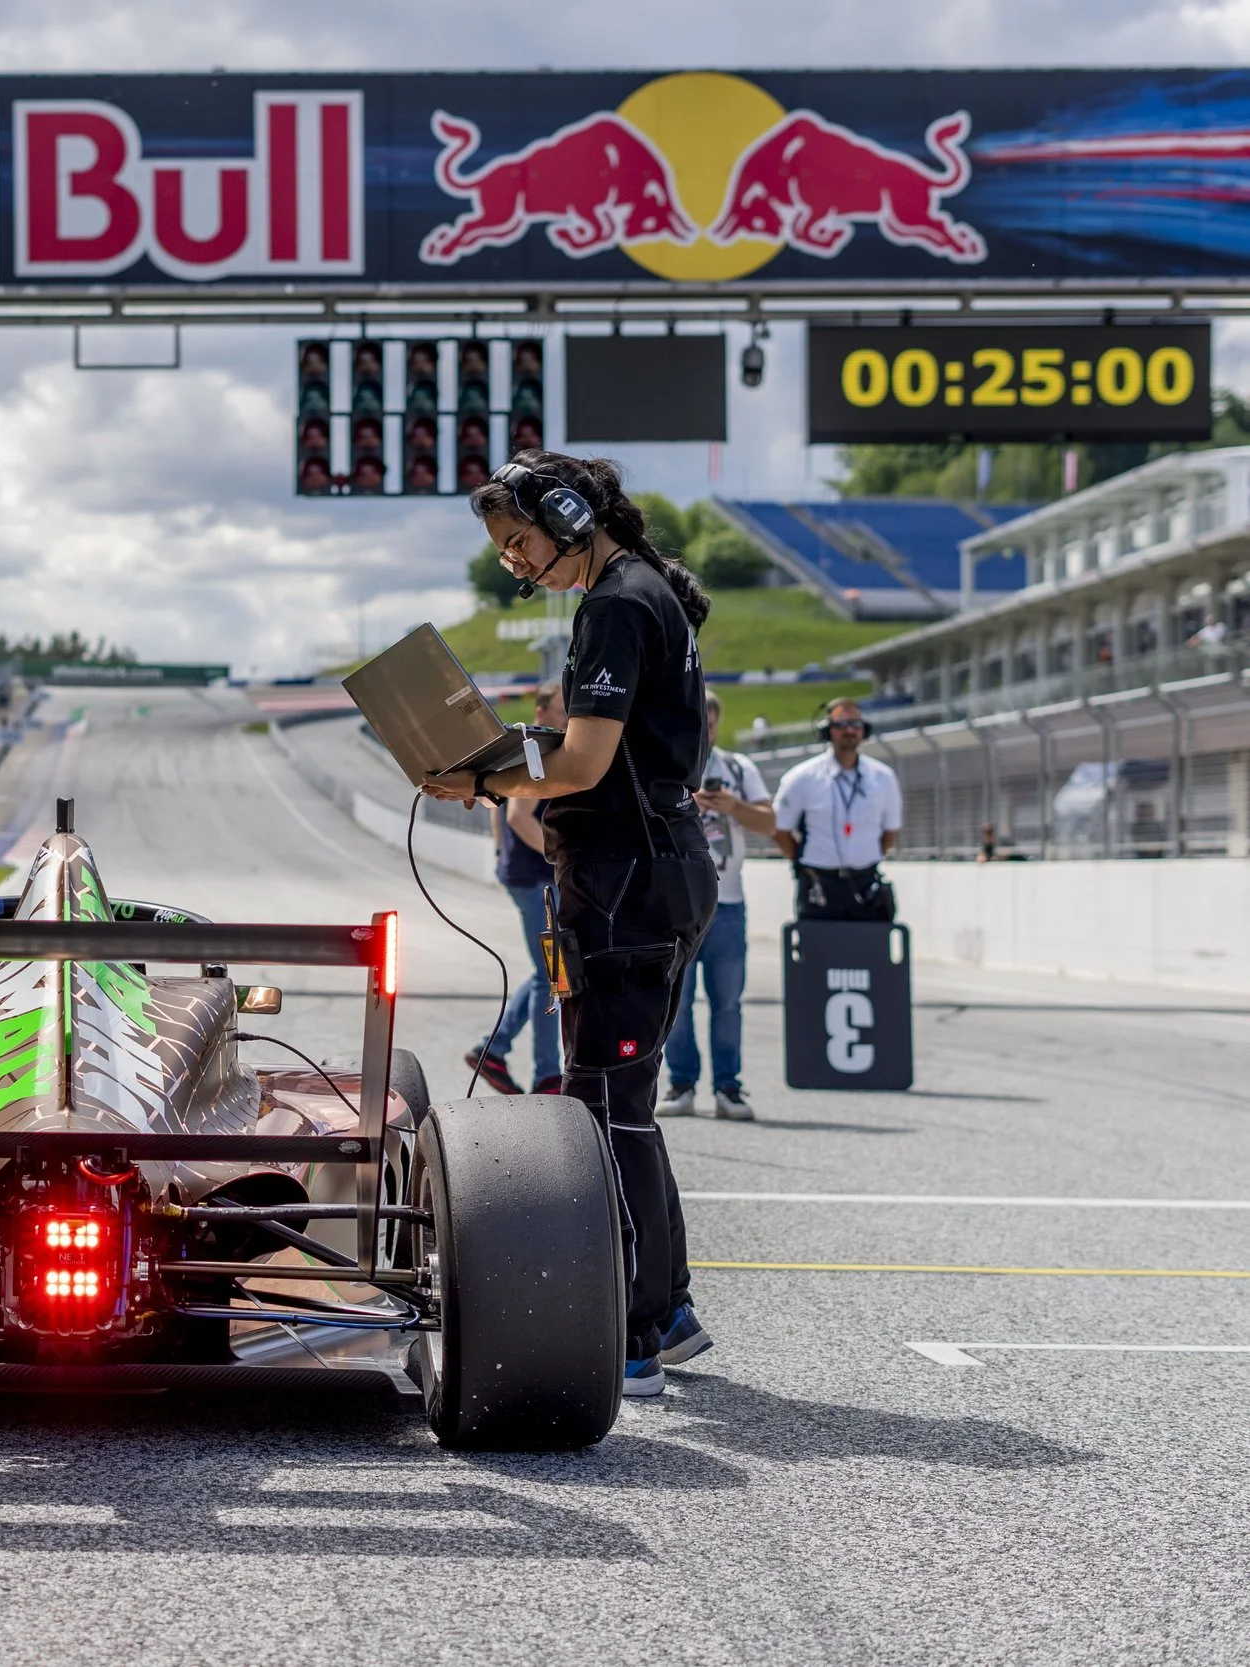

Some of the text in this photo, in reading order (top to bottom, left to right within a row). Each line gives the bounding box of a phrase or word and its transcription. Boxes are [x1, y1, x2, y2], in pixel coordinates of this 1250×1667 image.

[20, 98, 358, 271] Bull
[841, 346, 1195, 407] 00:25:00
[590, 684, 627, 695] INVESTMENT
[827, 968, 870, 992] min
[825, 991, 875, 1074] 3
